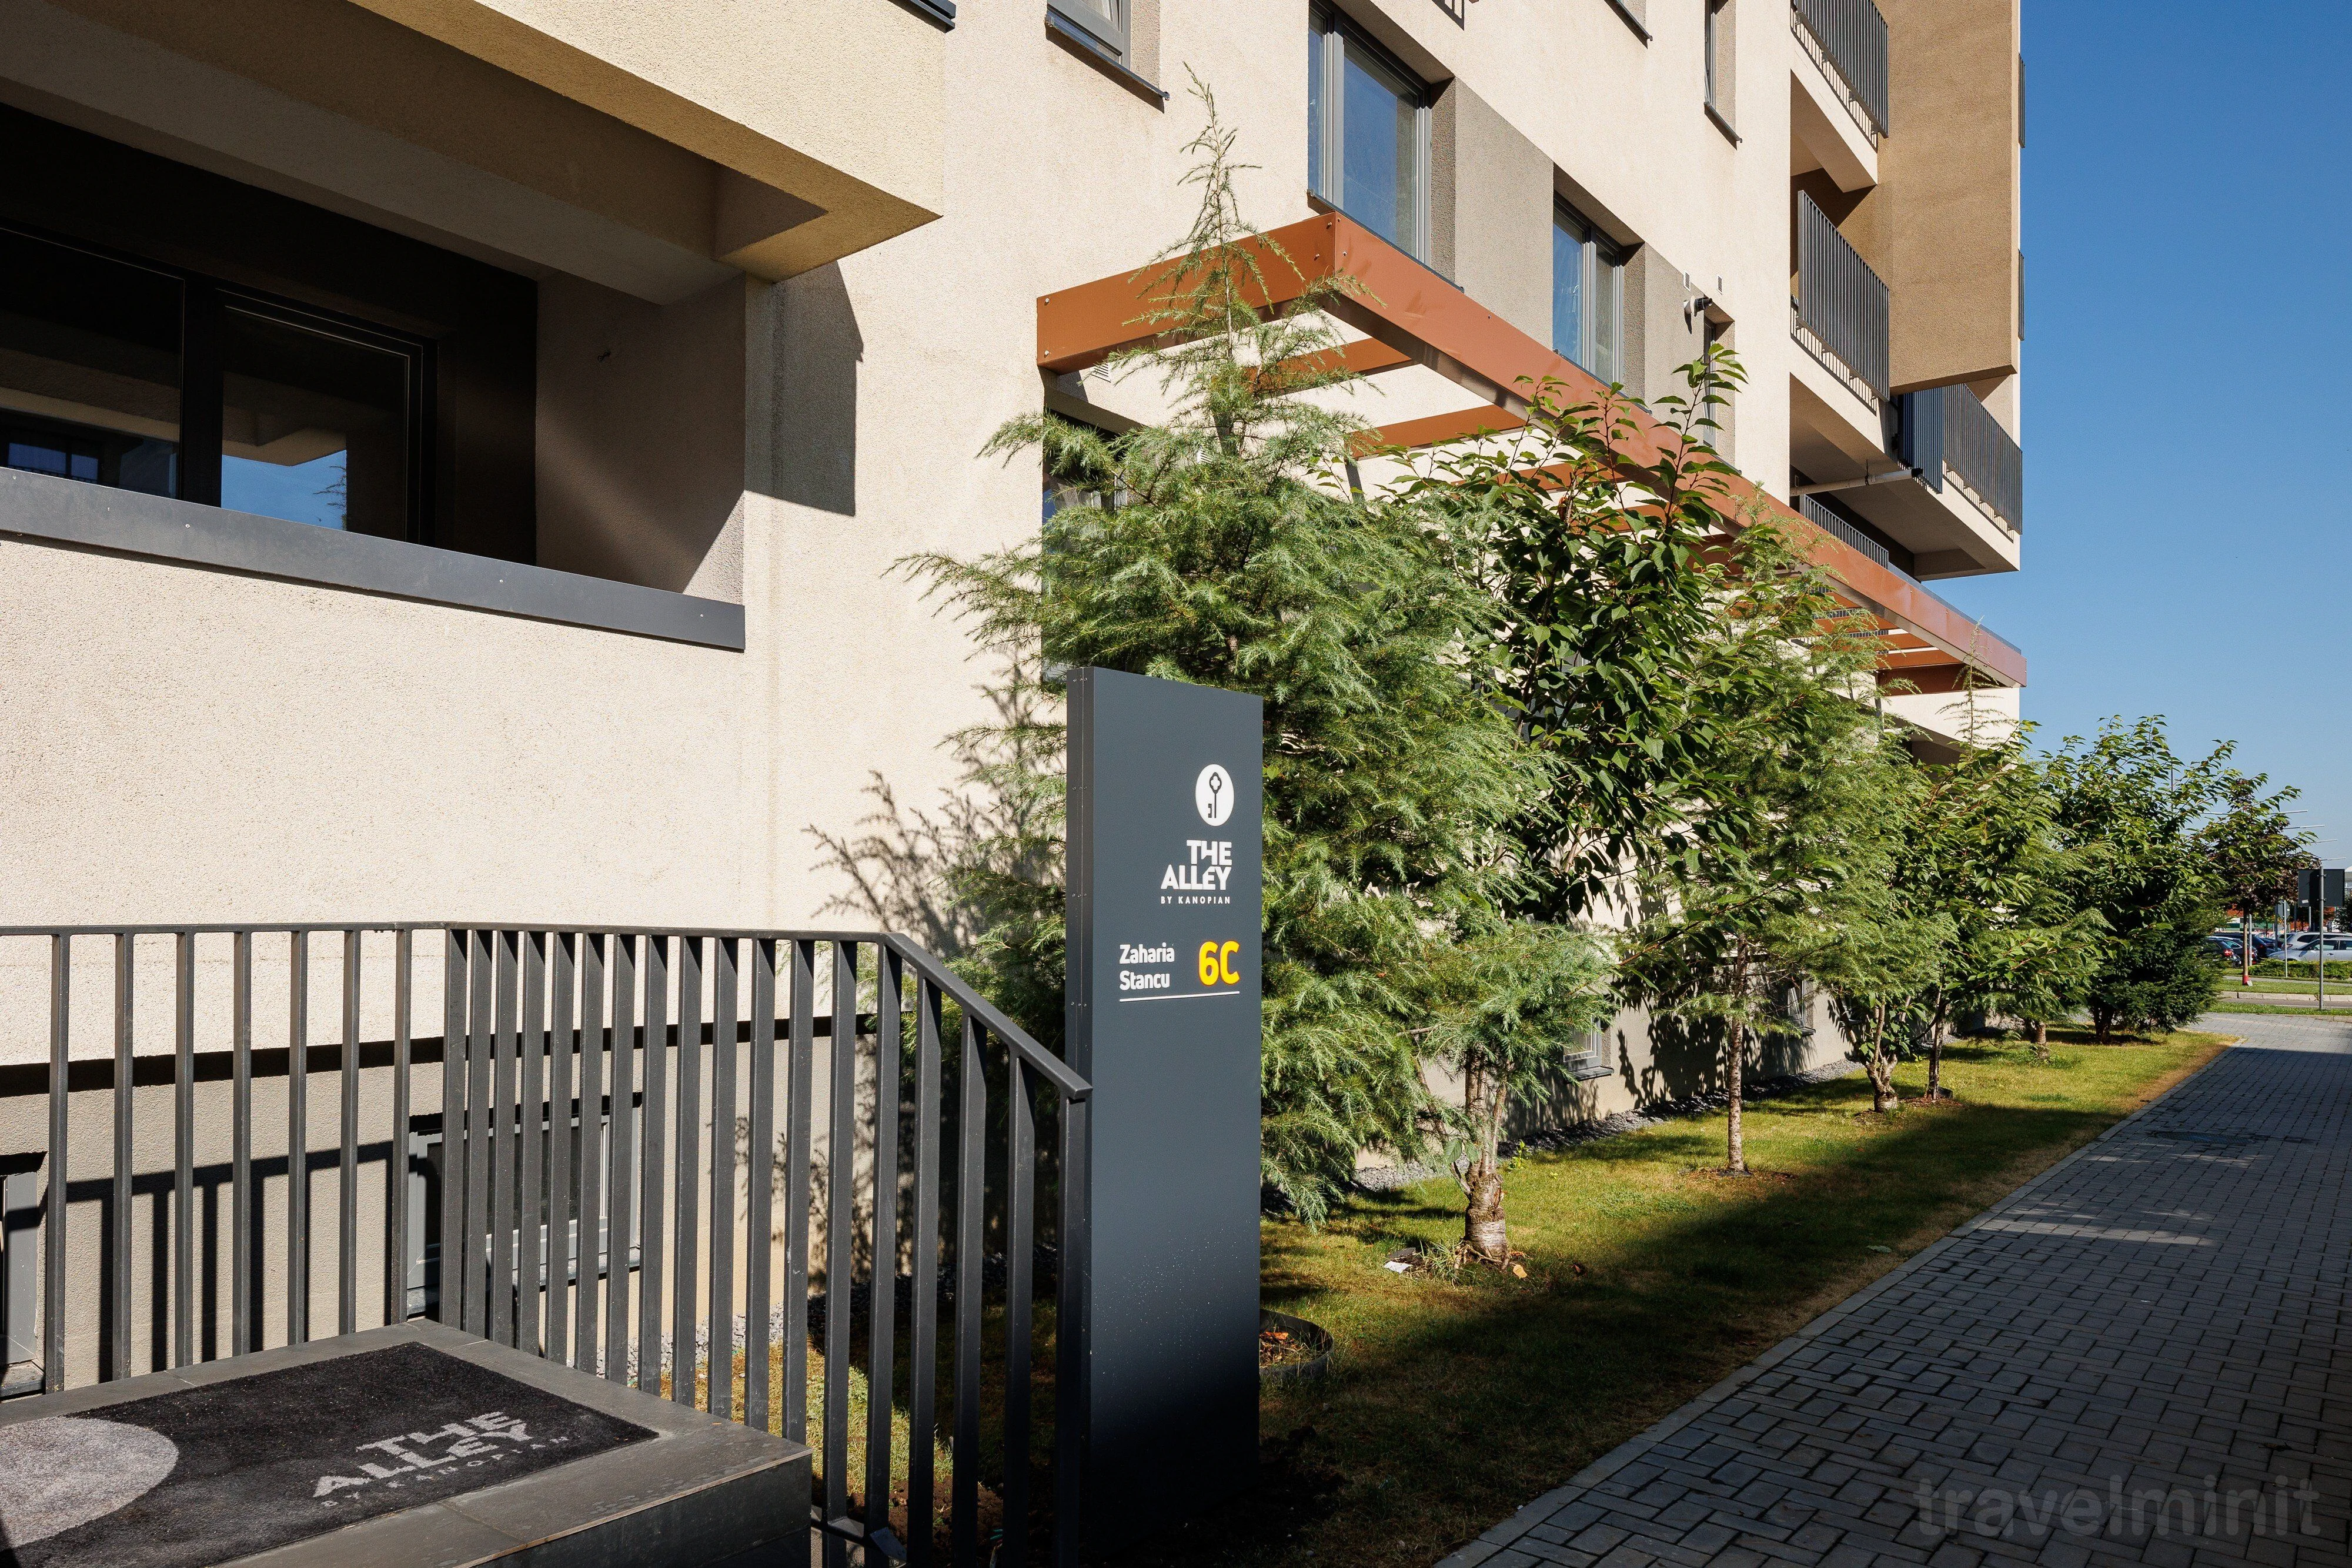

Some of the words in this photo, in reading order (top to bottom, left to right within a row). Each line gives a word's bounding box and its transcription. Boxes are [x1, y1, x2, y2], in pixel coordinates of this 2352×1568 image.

[1186, 840, 1232, 865] THE
[1160, 864, 1232, 890] ALLEY
[1160, 896, 1172, 904] BY
[1178, 895, 1231, 904] KANOPIAN
[1119, 942, 1175, 964] Zaharia
[1198, 940, 1241, 986] 6C
[1119, 970, 1170, 991] Stancu
[356, 1411, 526, 1456] THE
[312, 1422, 533, 1497] ALLEY
